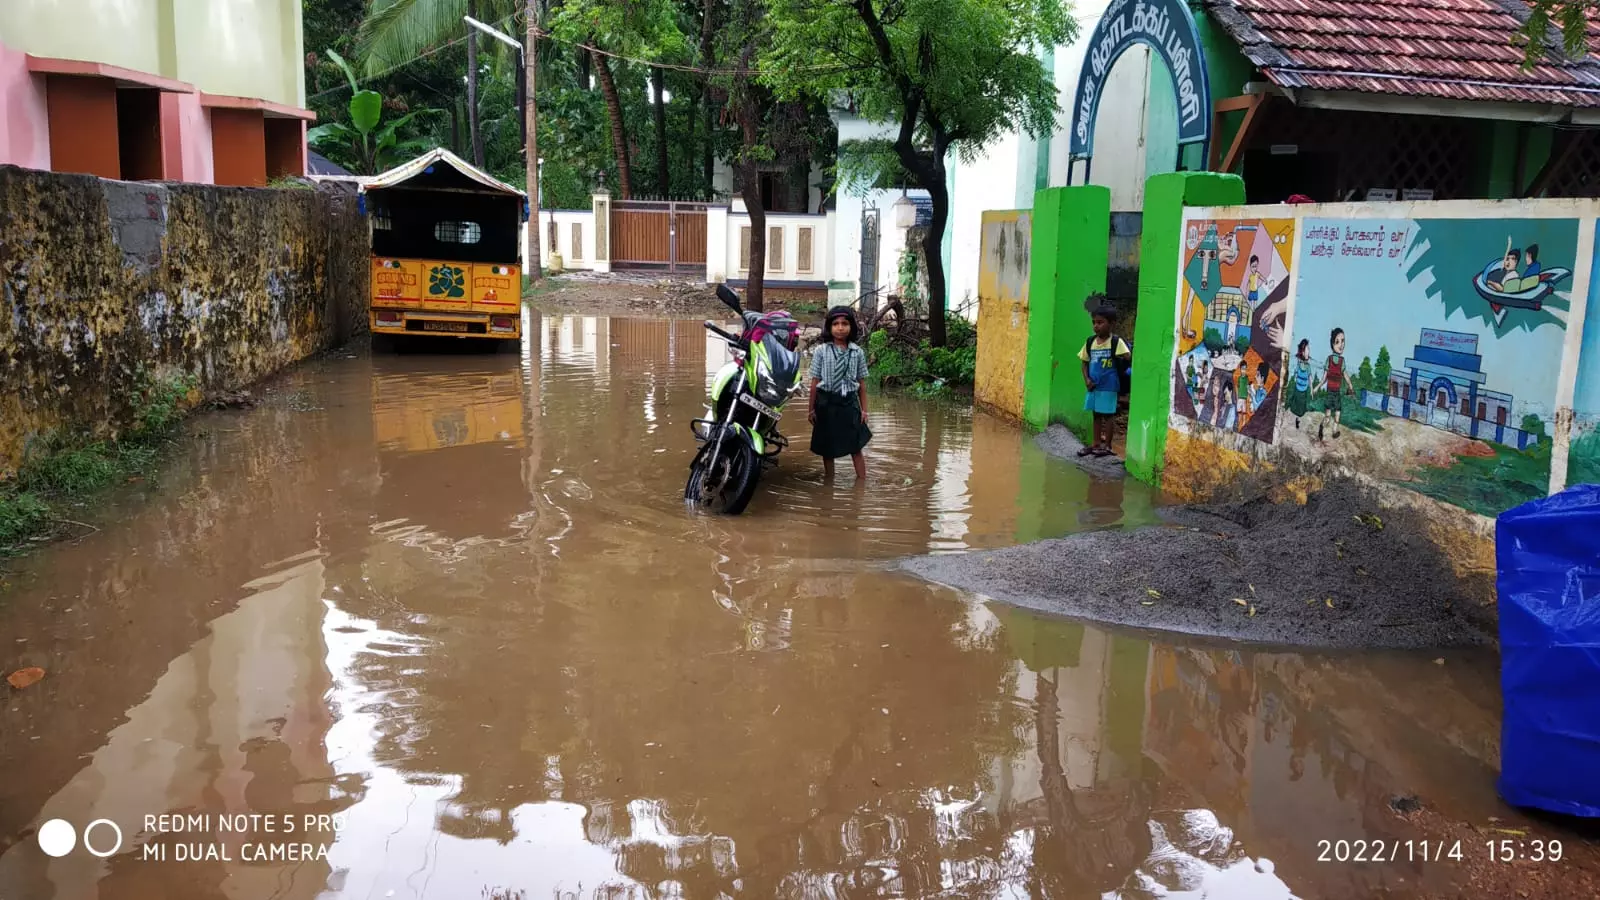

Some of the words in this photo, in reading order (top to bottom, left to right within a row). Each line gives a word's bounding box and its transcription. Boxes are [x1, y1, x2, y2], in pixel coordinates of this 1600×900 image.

[1077, 75, 1095, 145] அரசு
[1091, 0, 1169, 77] தொடக்கப்
[1165, 29, 1200, 128] பள்ளி
